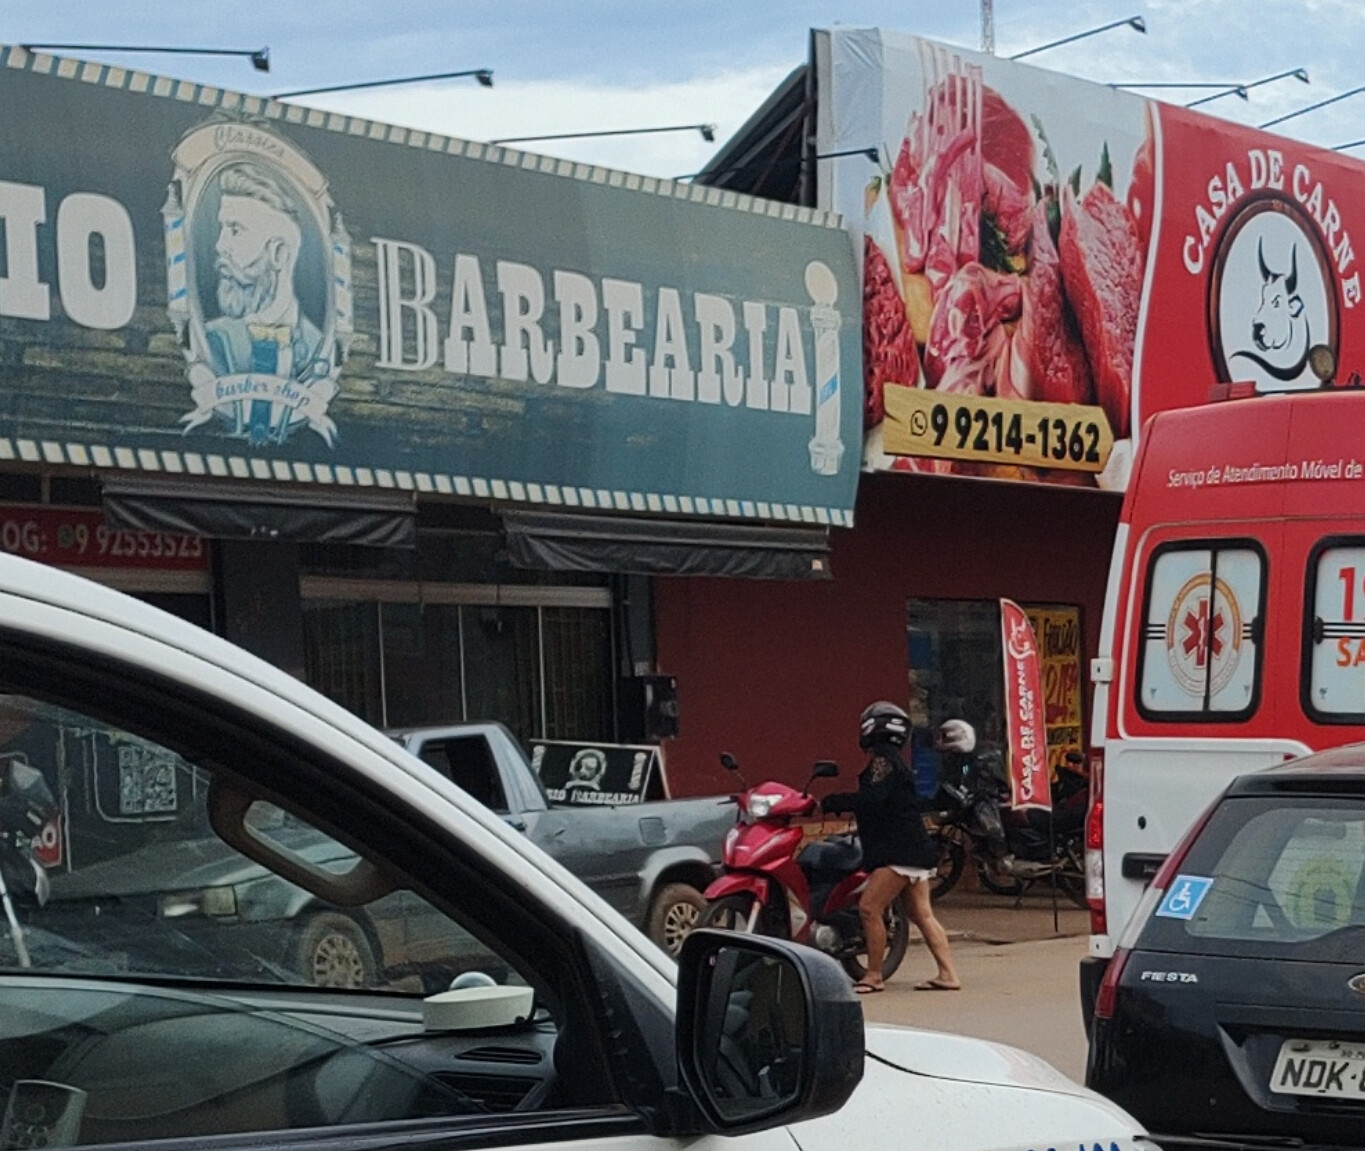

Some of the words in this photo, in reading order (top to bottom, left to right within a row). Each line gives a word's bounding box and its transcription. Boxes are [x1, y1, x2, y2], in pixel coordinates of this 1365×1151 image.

[1183, 162, 1244, 275] CASA
[1248, 149, 1284, 190] DE
[1293, 165, 1361, 308] CARNE
[370, 237, 811, 415] BARBEARIA
[931, 404, 948, 446] 9
[955, 407, 1100, 463] 9214-1362
[1168, 468, 1204, 489] Serviço
[1206, 466, 1220, 485] de
[1222, 462, 1298, 484] Atendimento
[1300, 459, 1342, 480] Móvel
[1344, 459, 1361, 480] de
[1140, 970, 1198, 983] FIESTA
